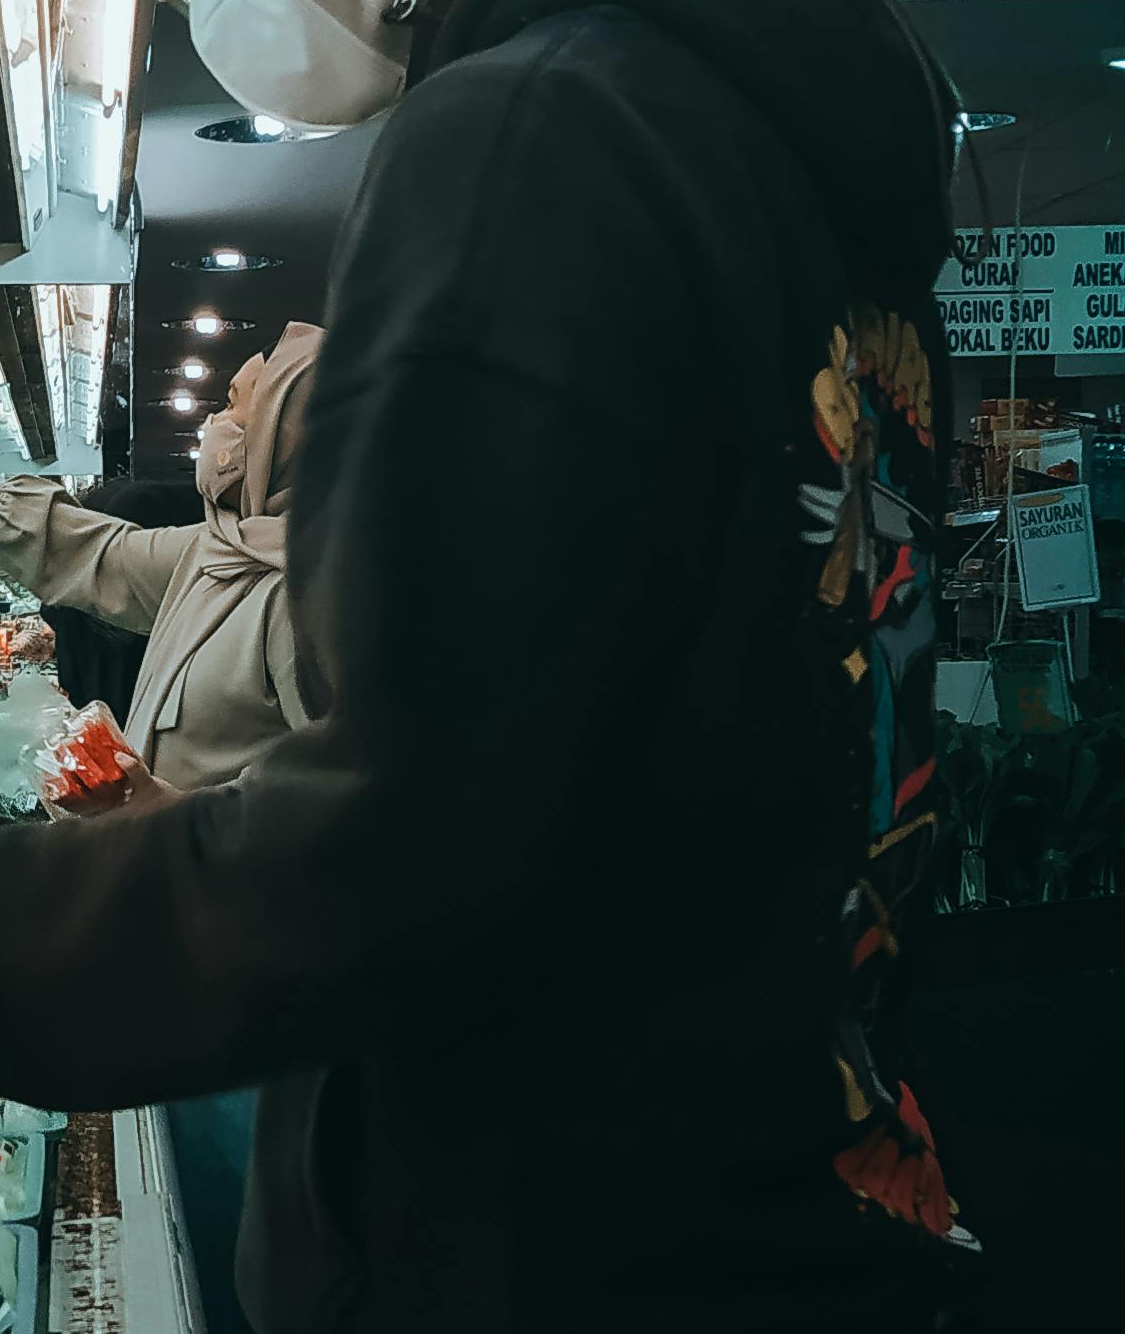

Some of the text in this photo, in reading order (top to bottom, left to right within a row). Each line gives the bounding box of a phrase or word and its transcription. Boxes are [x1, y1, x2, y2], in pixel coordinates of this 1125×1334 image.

[1006, 232, 1055, 257] FOOD
[1072, 262, 1125, 287] ANEK
[938, 298, 1050, 324] DAGING SAPI
[1087, 294, 1125, 318] GUL
[946, 327, 1050, 352] OKAL BEKU
[1019, 501, 1084, 527] SAYURAN
[1021, 519, 1085, 541] ORGANIK
